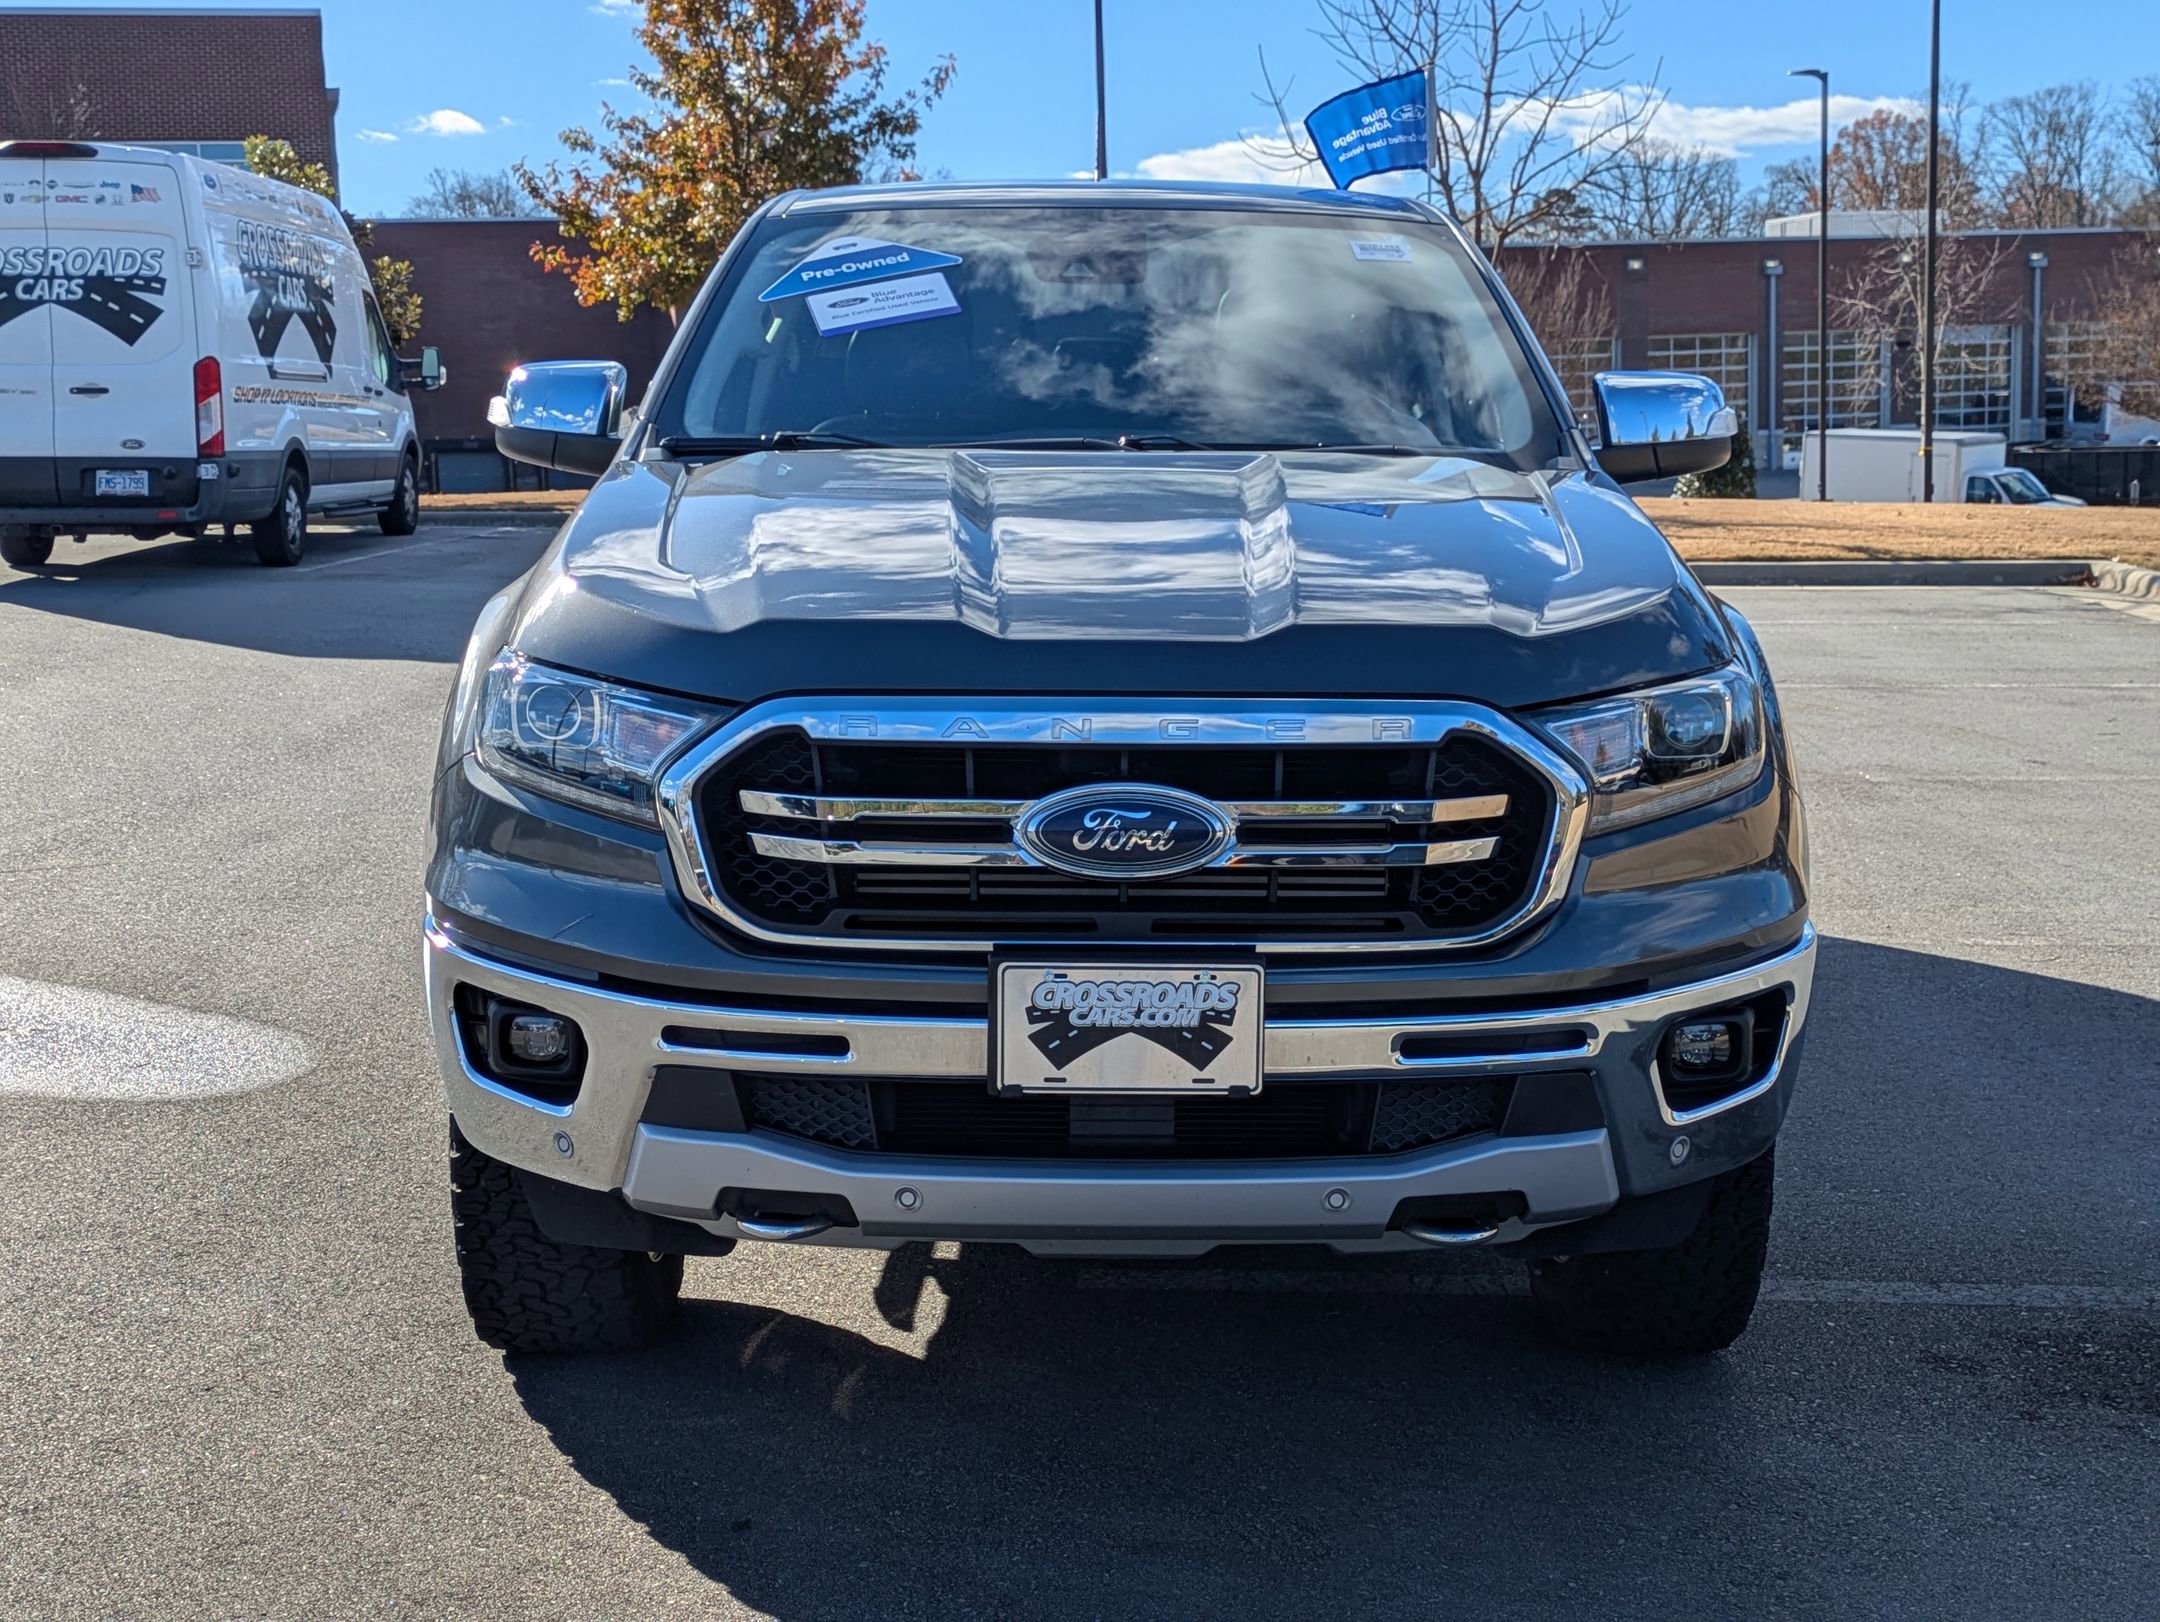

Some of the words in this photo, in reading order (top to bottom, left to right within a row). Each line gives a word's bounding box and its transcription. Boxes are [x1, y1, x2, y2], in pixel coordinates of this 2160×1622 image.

[100, 180, 120, 190] Jeep
[0, 247, 165, 278] SSROADS
[801, 252, 911, 282] Pre-Owned
[14, 278, 85, 301] CARS
[278, 275, 308, 308] CARS
[871, 289, 897, 298] Blue
[874, 288, 935, 304] Advantage
[233, 386, 261, 403] SHOP
[838, 713, 1413, 741] RANGER
[1072, 807, 1176, 855] Ford
[1031, 980, 1240, 1011] CROSSROADS
[1068, 1007, 1201, 1028] CARS.COM
